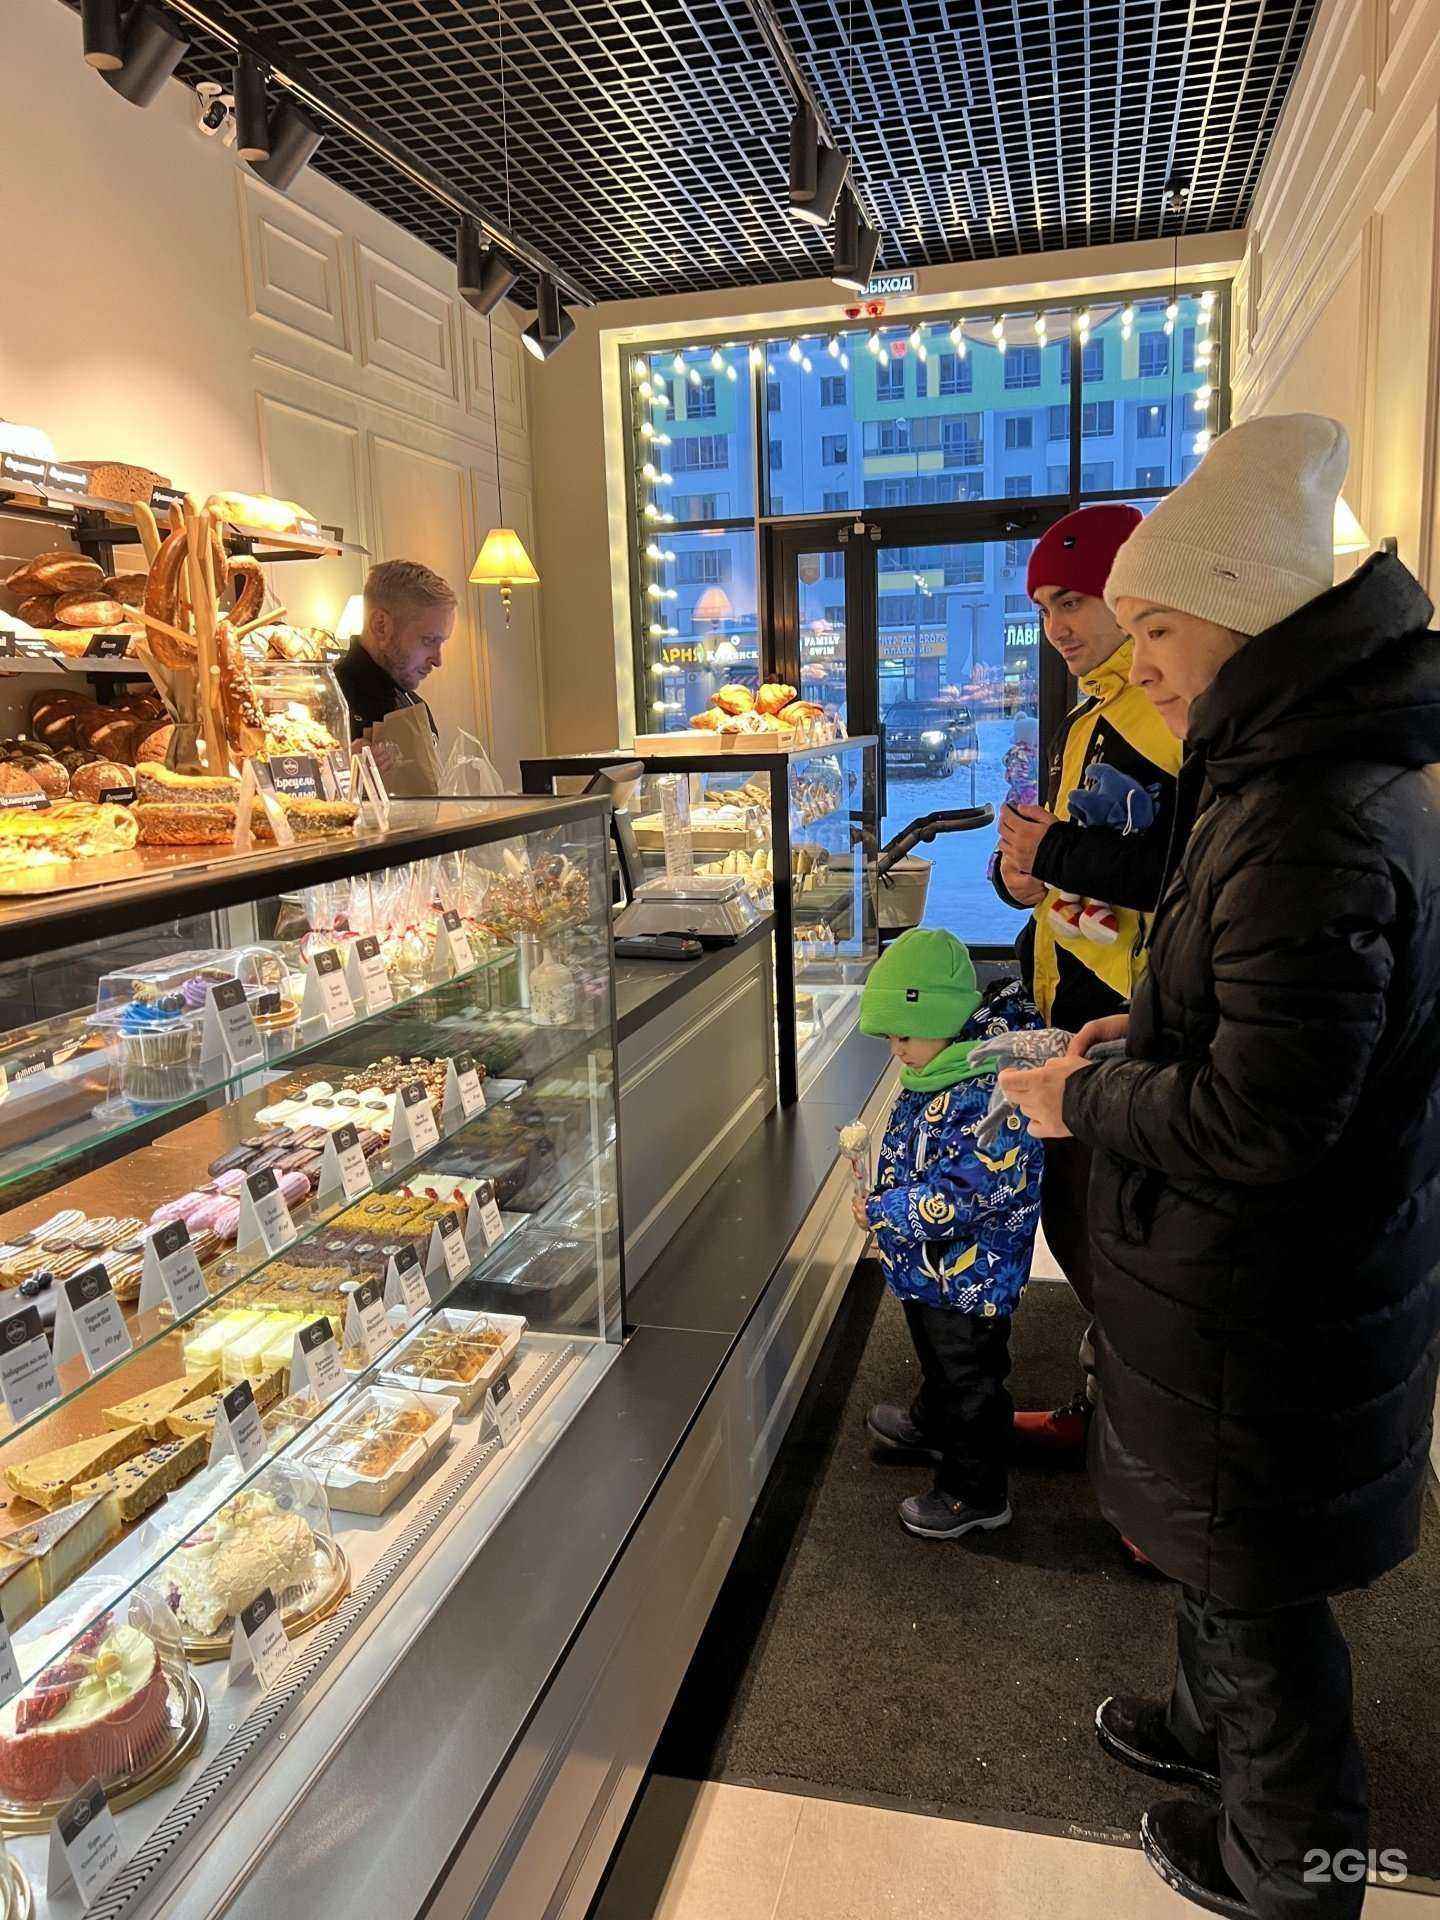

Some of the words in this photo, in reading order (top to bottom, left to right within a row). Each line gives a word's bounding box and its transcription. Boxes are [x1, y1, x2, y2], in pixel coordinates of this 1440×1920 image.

[861, 276, 912, 294] ЫХОД
[804, 635, 840, 647] FAMILY
[809, 647, 835, 656] SWIM
